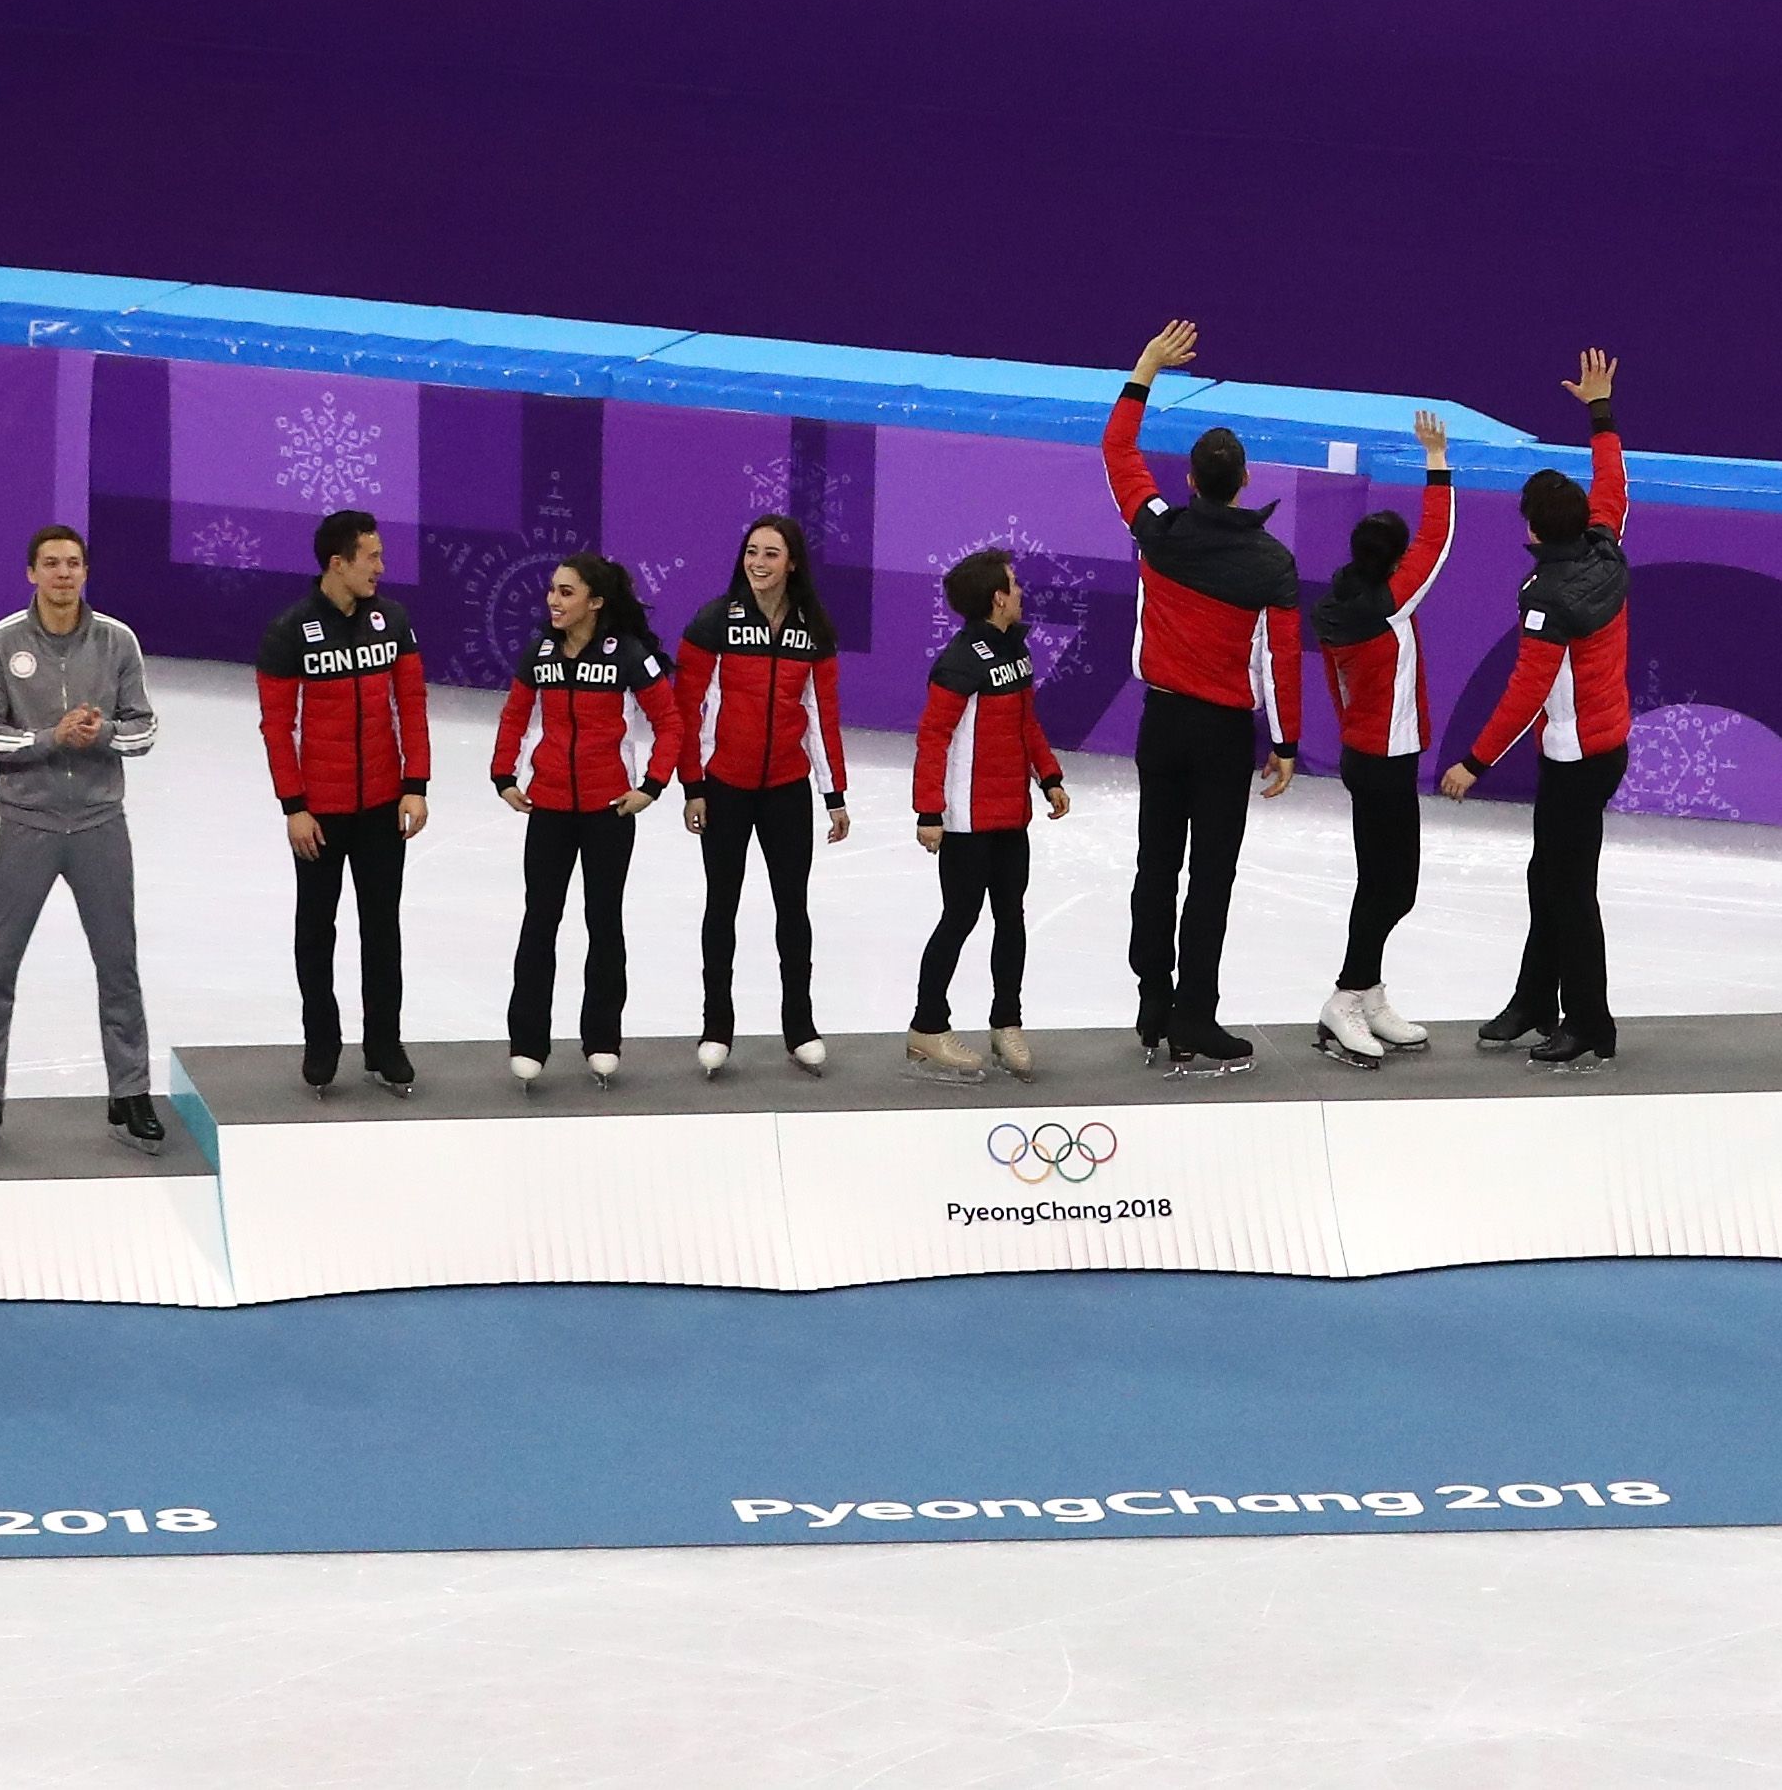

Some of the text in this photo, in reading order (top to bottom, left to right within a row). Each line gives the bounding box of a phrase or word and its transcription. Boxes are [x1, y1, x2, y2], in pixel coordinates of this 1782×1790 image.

[947, 1198, 1173, 1227] PyeongChang 2018
[731, 1481, 1671, 1529] PyeongChang 2018
